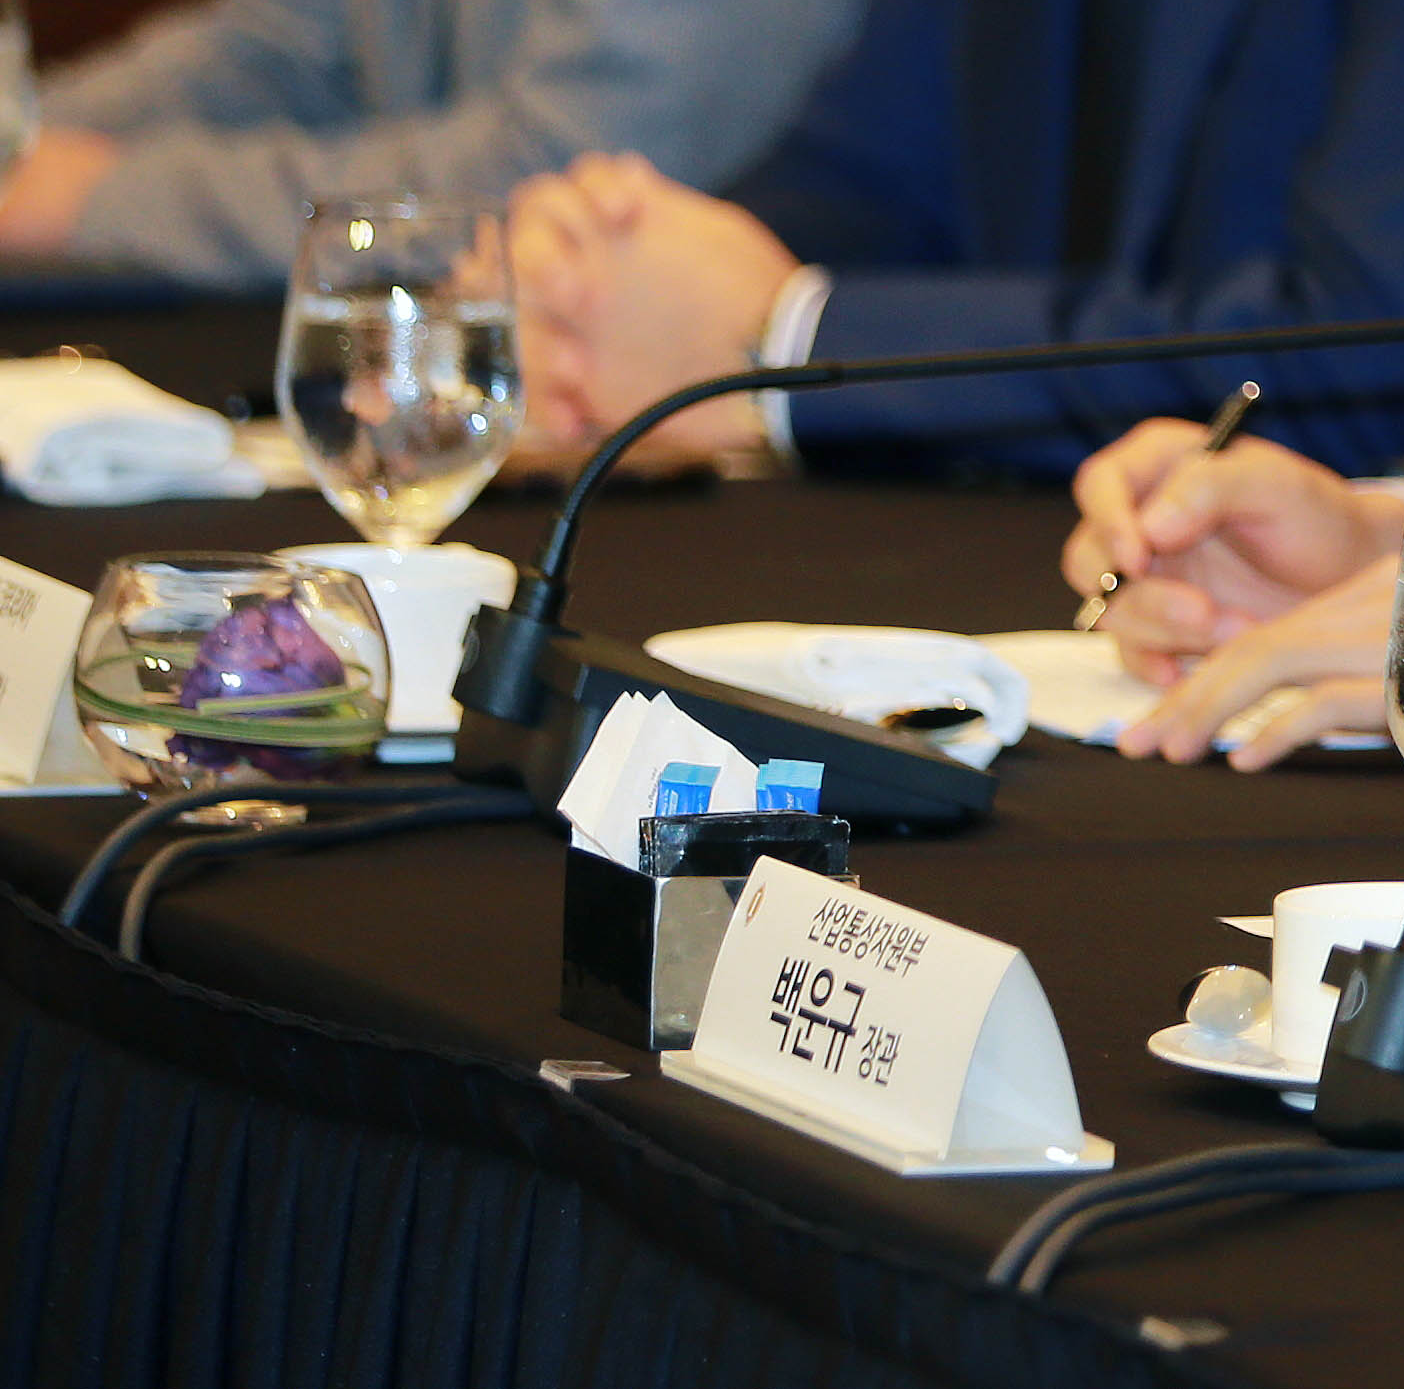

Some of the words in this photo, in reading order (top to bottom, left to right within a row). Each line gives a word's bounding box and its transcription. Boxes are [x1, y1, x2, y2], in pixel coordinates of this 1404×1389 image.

[808, 897, 930, 978] 산업통상자원부
[770, 957, 866, 1073] 백운규
[859, 1026, 902, 1087] 장관
